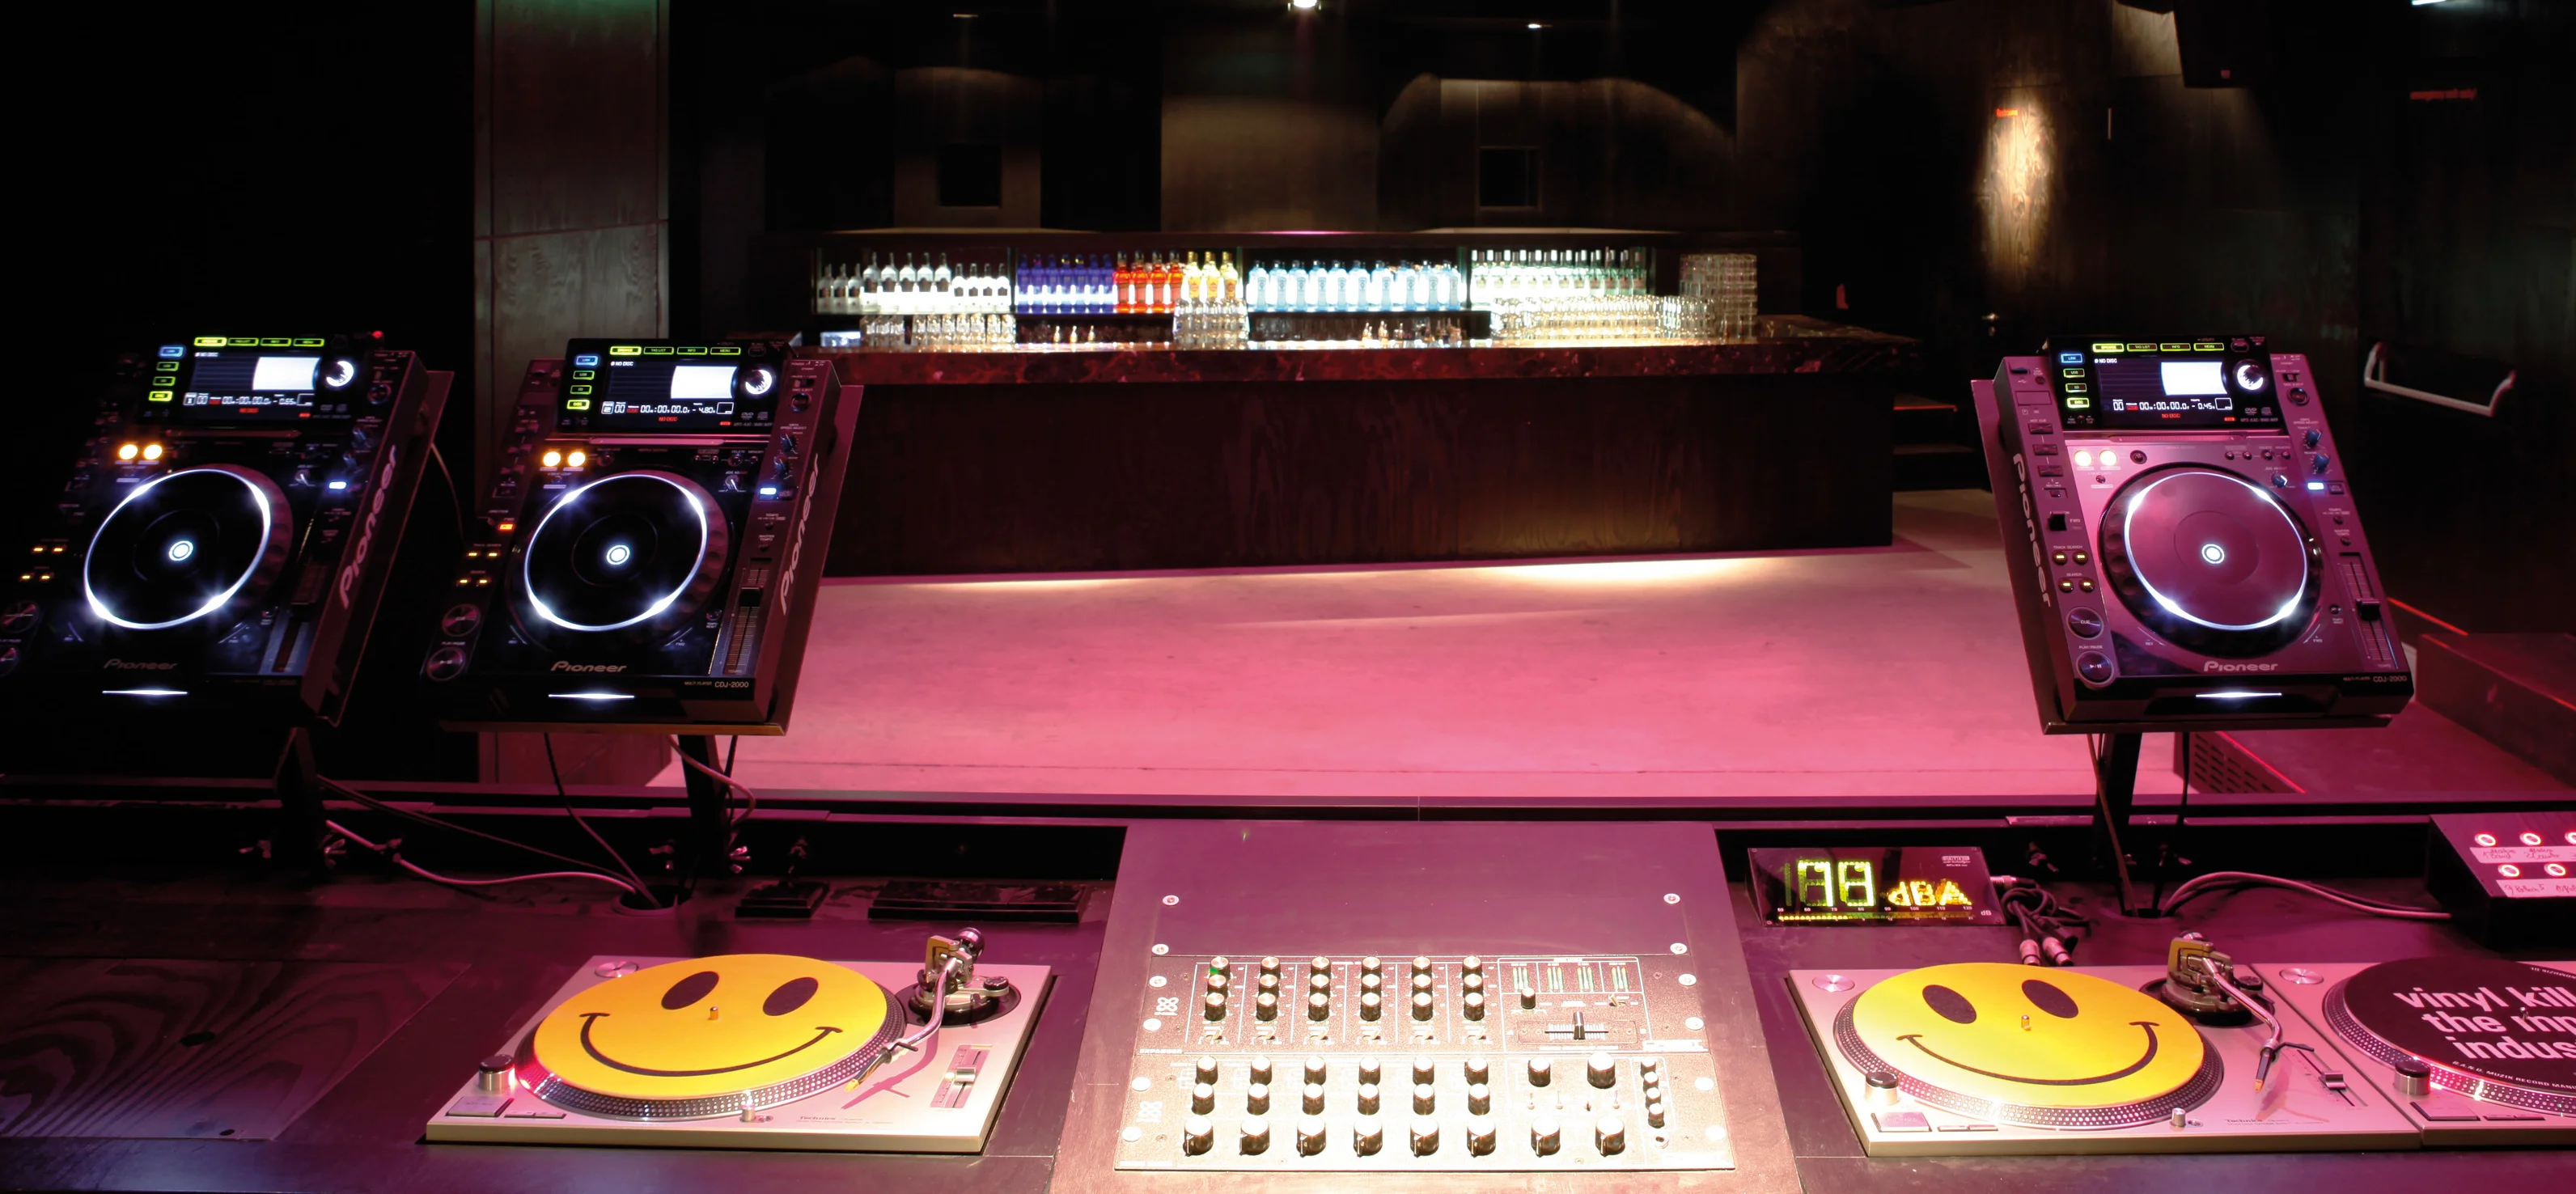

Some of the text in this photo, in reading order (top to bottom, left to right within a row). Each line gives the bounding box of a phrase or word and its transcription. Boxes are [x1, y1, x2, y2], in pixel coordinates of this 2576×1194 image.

[339, 445, 396, 609] Pioneer
[780, 452, 819, 616] Pioneer
[2013, 453, 2051, 608] Pioneer
[103, 658, 178, 670] Pioneer
[550, 661, 627, 673] Pioneer
[2204, 661, 2278, 672] Pioneer
[1888, 880, 1972, 907] dBA
[2393, 987, 2509, 1012] vinyl
[2421, 1011, 2507, 1032] the
[2445, 1036, 2576, 1059] indus
[2486, 1070, 2514, 1080] MUZIK
[2515, 1077, 2549, 1086] RECORD
